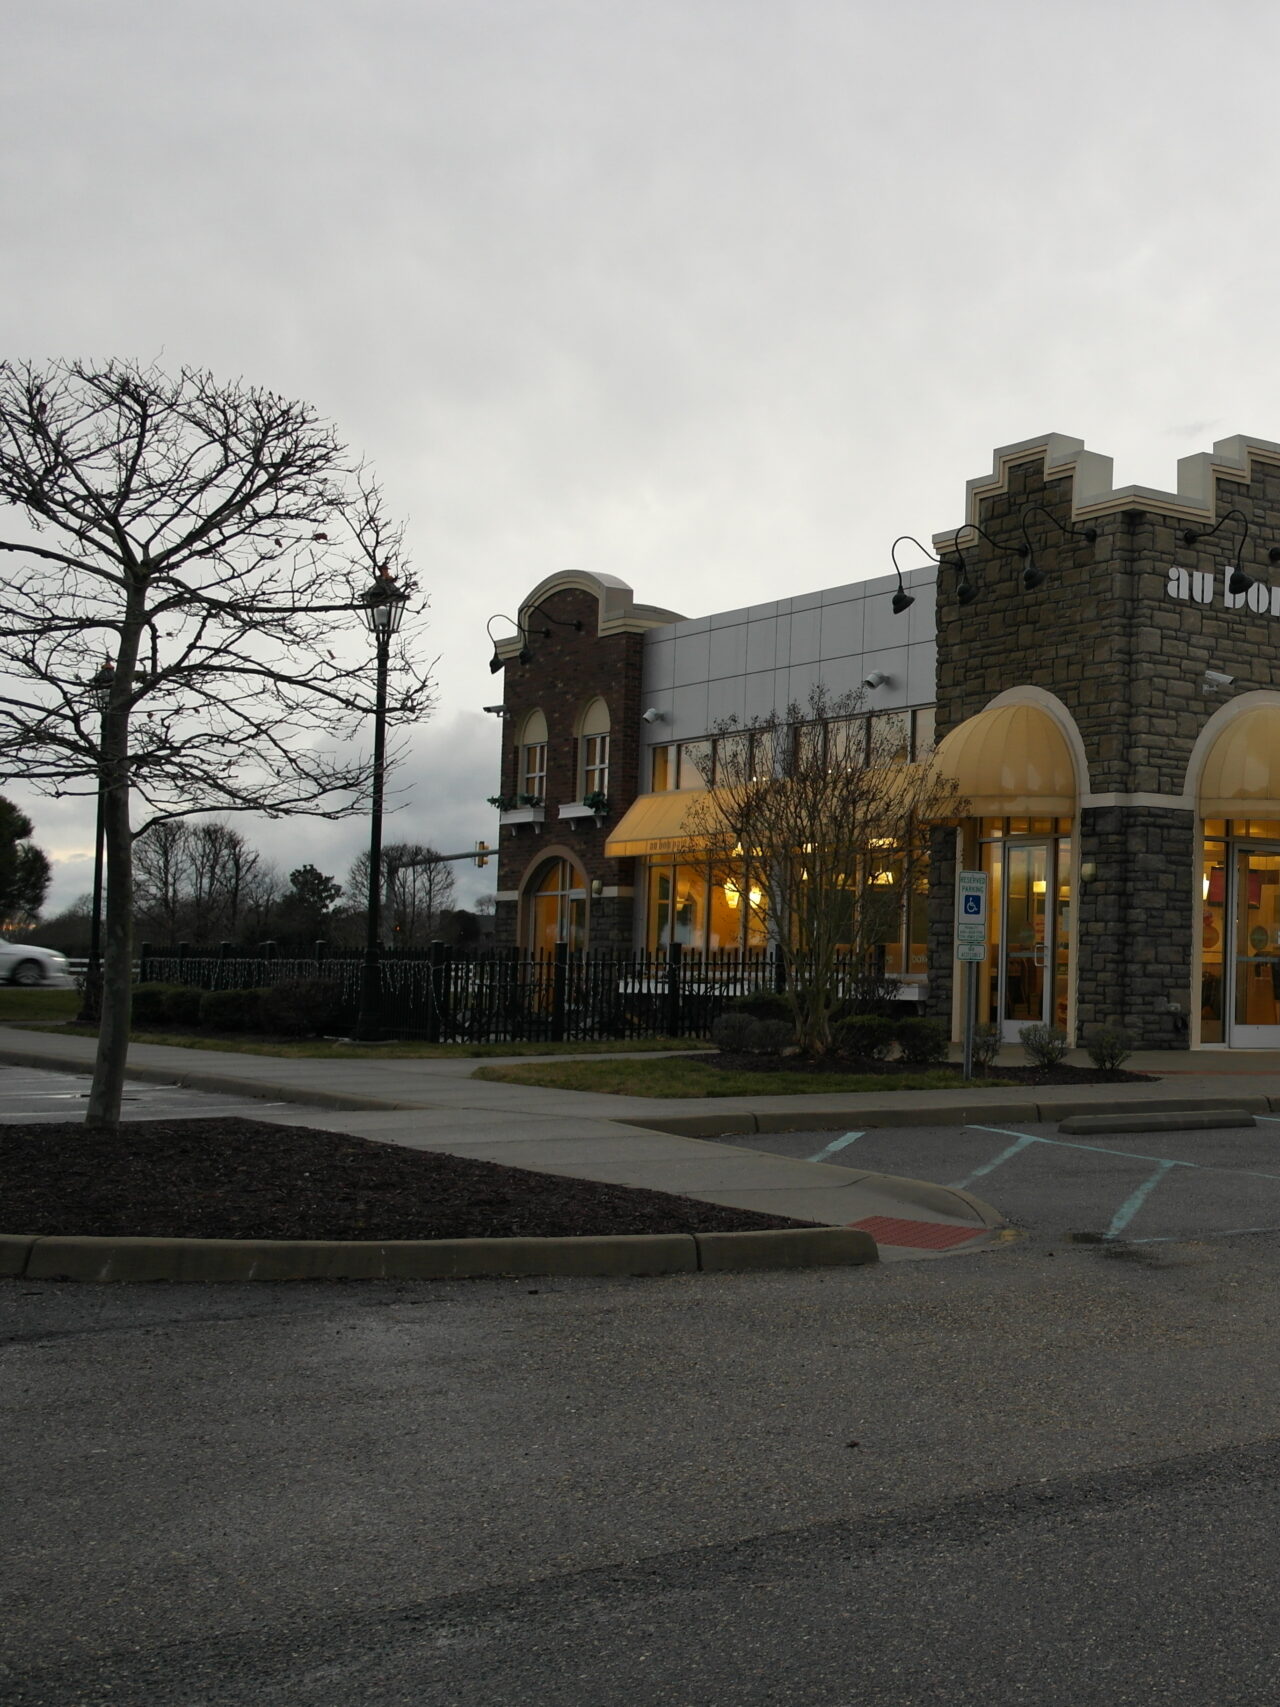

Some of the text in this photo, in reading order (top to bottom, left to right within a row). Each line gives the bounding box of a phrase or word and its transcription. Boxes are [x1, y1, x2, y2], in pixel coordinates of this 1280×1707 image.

[1167, 567, 1214, 604] au
[960, 876, 986, 885] RESERVED
[961, 885, 985, 894] PARKING
